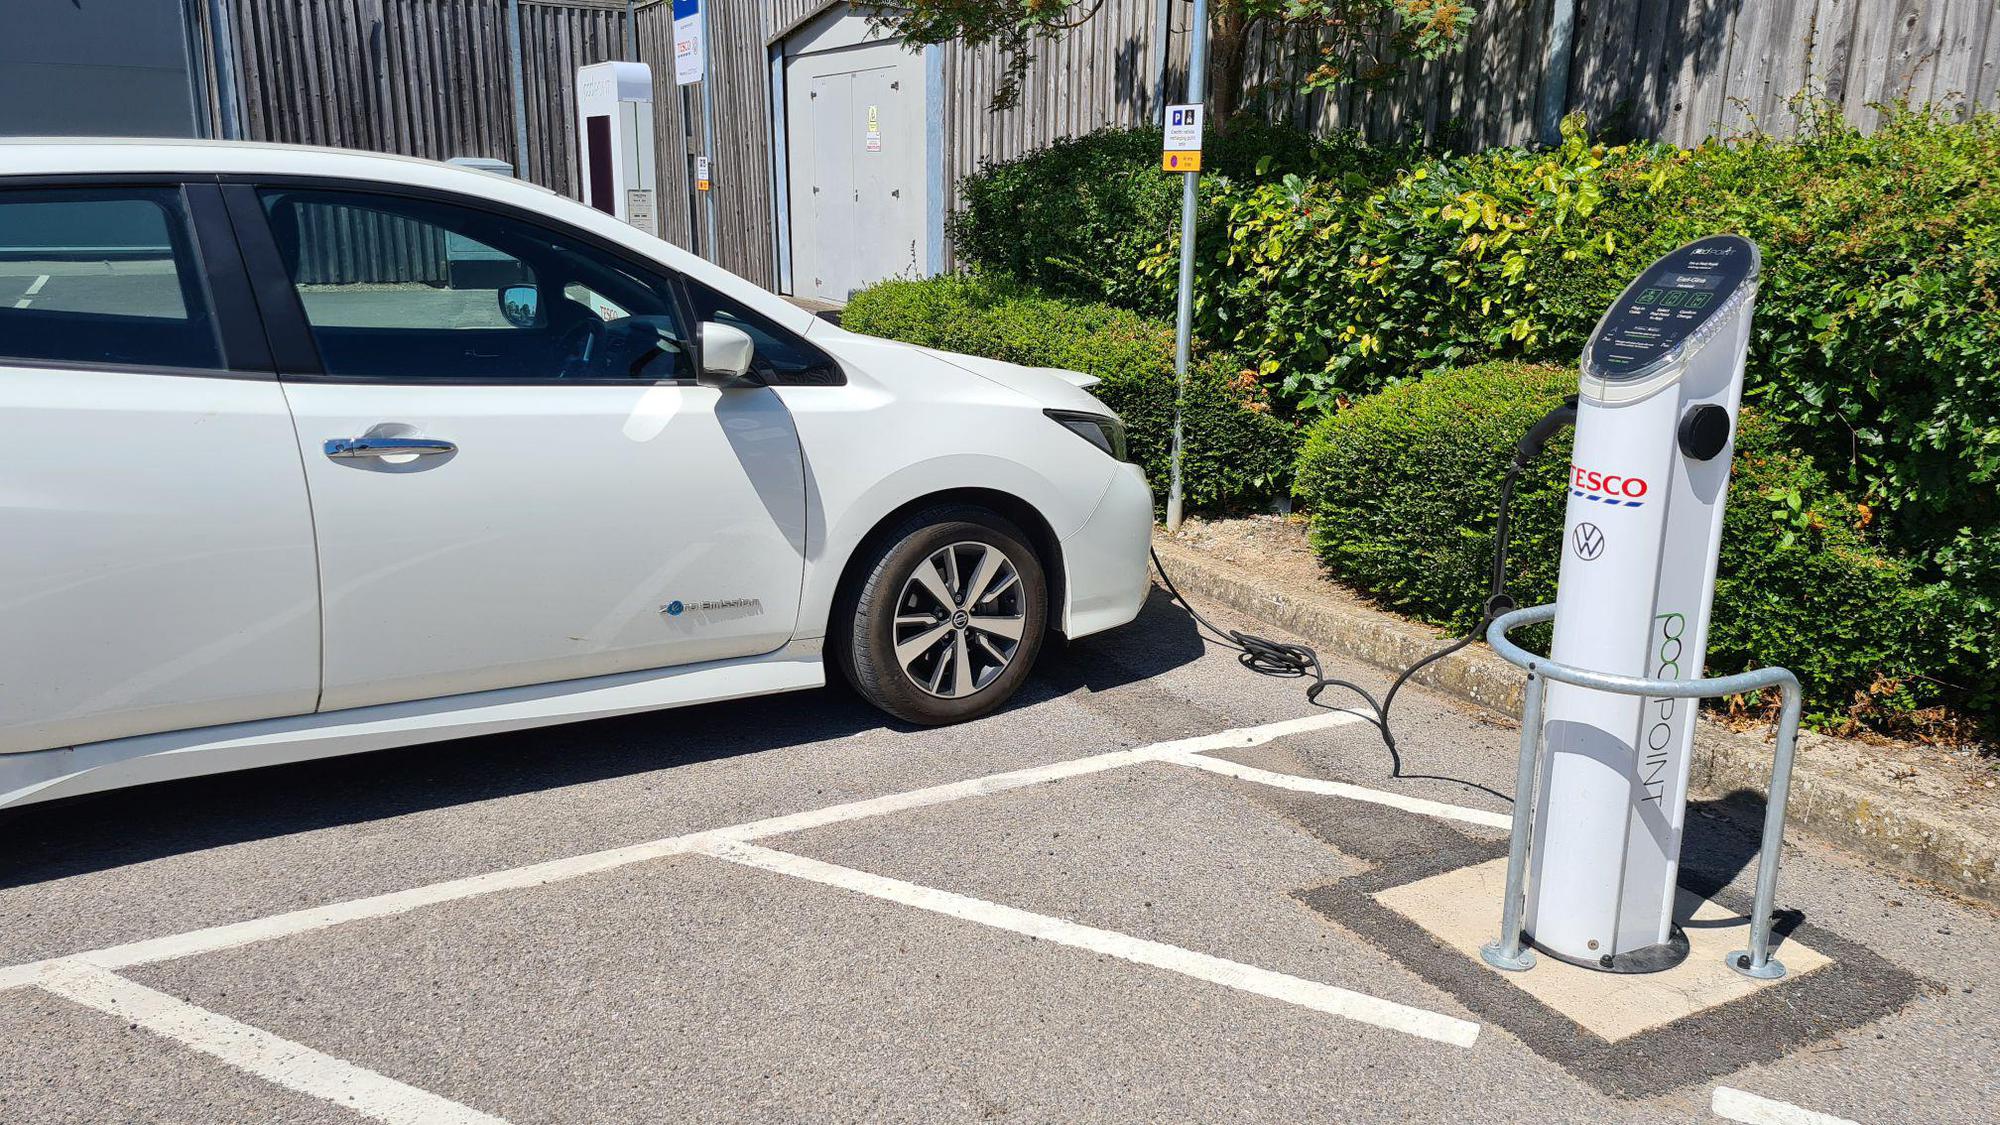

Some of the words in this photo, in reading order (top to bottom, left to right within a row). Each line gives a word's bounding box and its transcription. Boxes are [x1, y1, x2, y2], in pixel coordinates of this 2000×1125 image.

[600, 304, 618, 321] TESCO
[1568, 463, 1648, 498] TESCO
[1641, 697, 1676, 807] POINT
